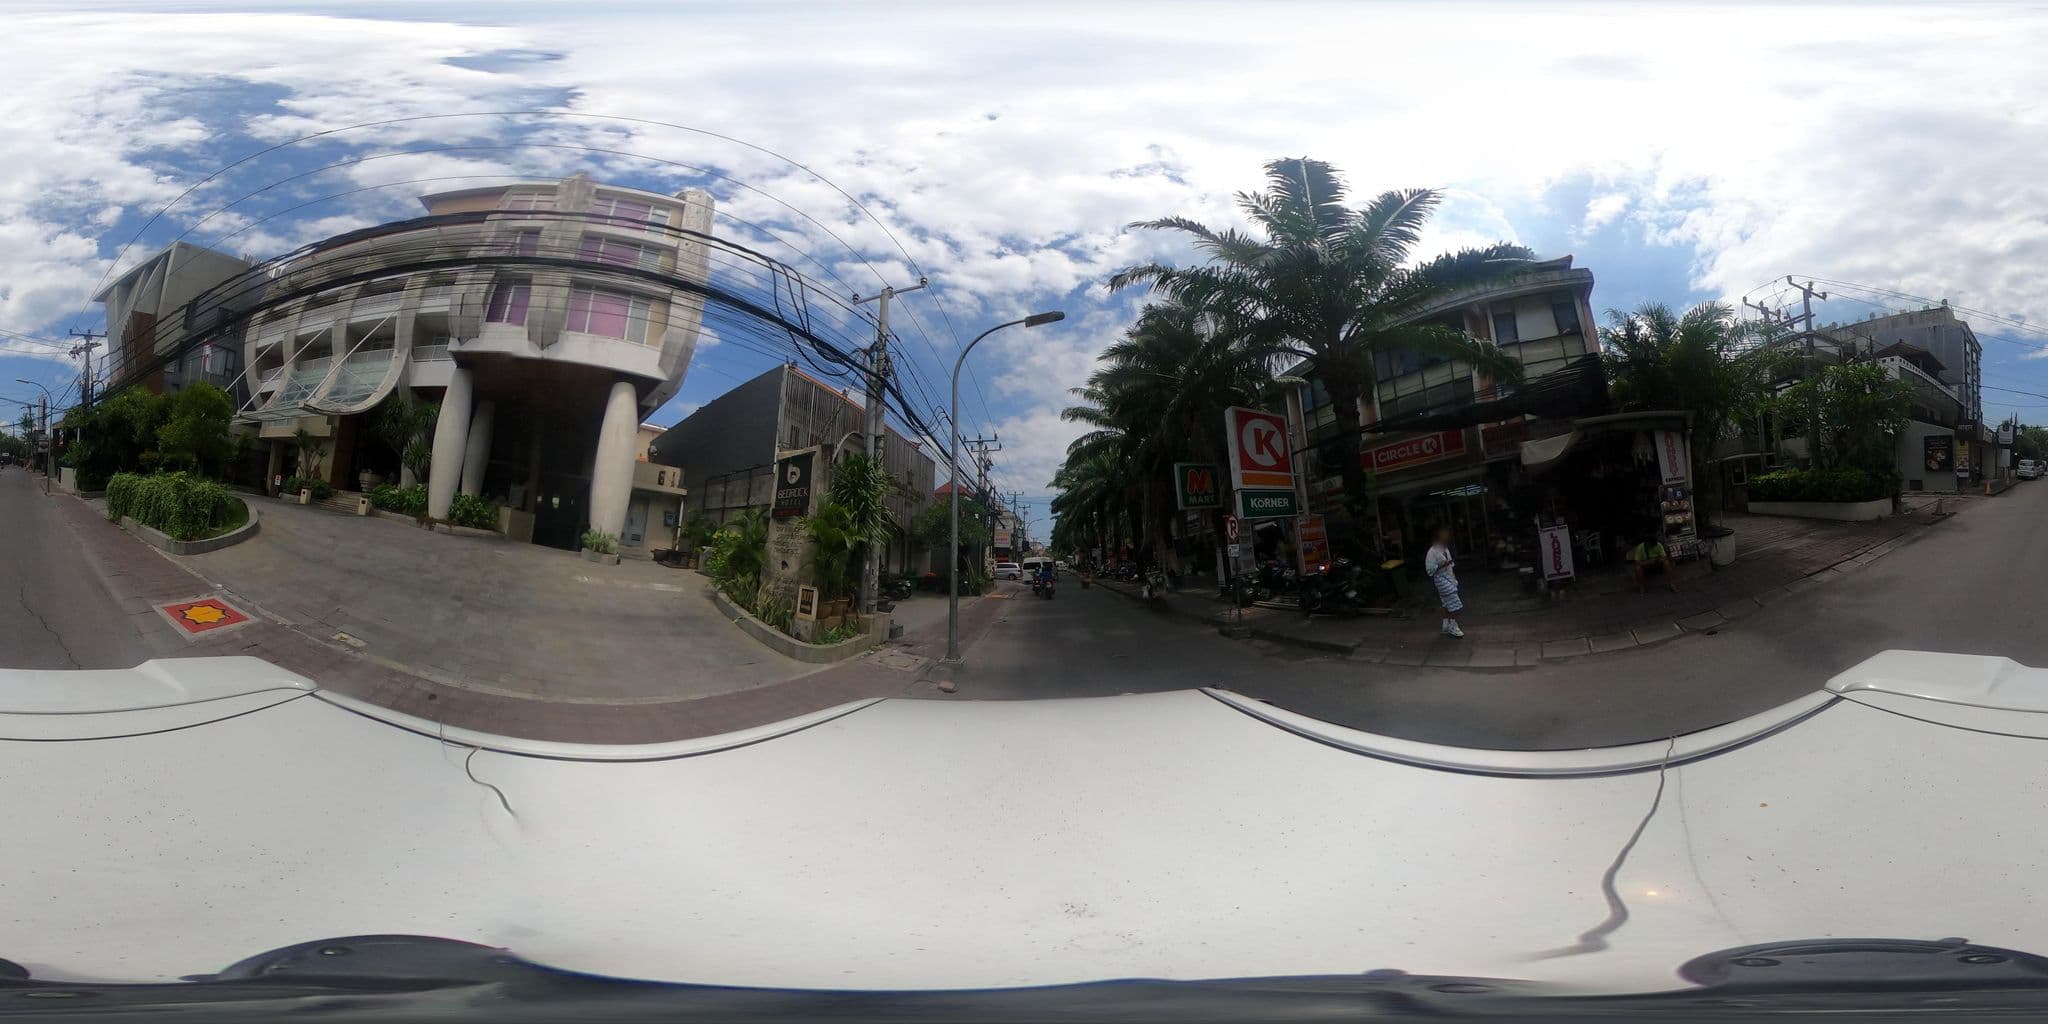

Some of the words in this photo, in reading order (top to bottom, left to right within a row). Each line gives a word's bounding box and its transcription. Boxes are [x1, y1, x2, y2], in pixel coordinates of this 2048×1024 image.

[1252, 427, 1282, 464] K
[1378, 444, 1420, 463] CIRCLE
[1422, 438, 1437, 454] K
[778, 487, 808, 499] BEDROCK
[1189, 496, 1215, 505] MART
[1250, 497, 1289, 509] KÖRNER
